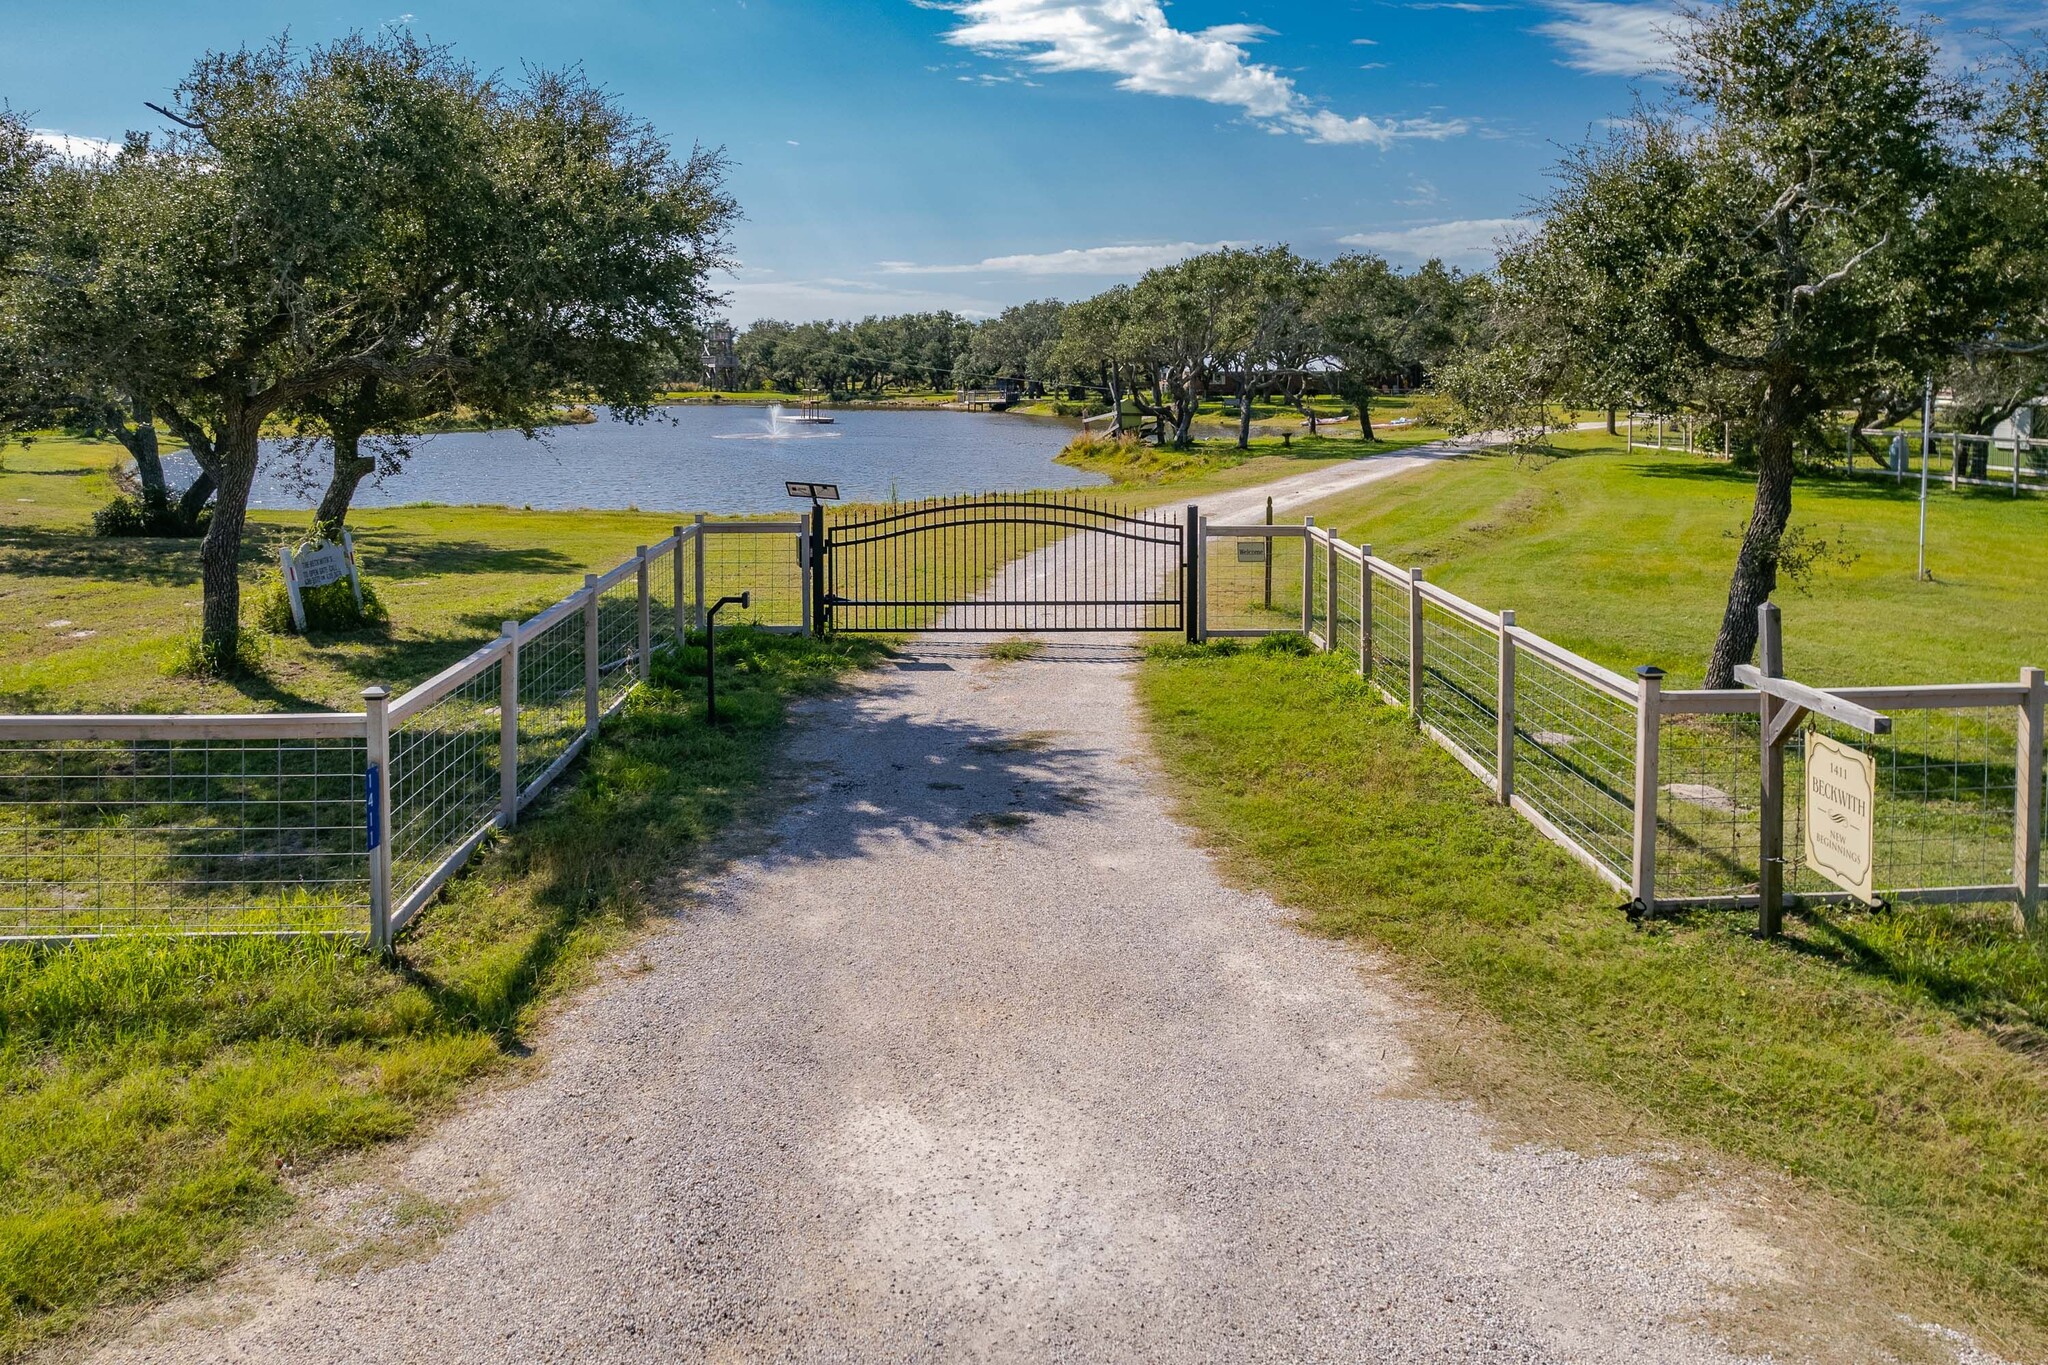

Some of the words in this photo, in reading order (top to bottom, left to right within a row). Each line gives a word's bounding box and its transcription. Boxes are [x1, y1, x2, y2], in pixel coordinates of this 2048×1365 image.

[1830, 762, 1847, 780] 1411
[1812, 776, 1866, 817] BECKWITH
[1816, 832, 1862, 865] BEGINNINGS
[1829, 830, 1846, 843] NEW
